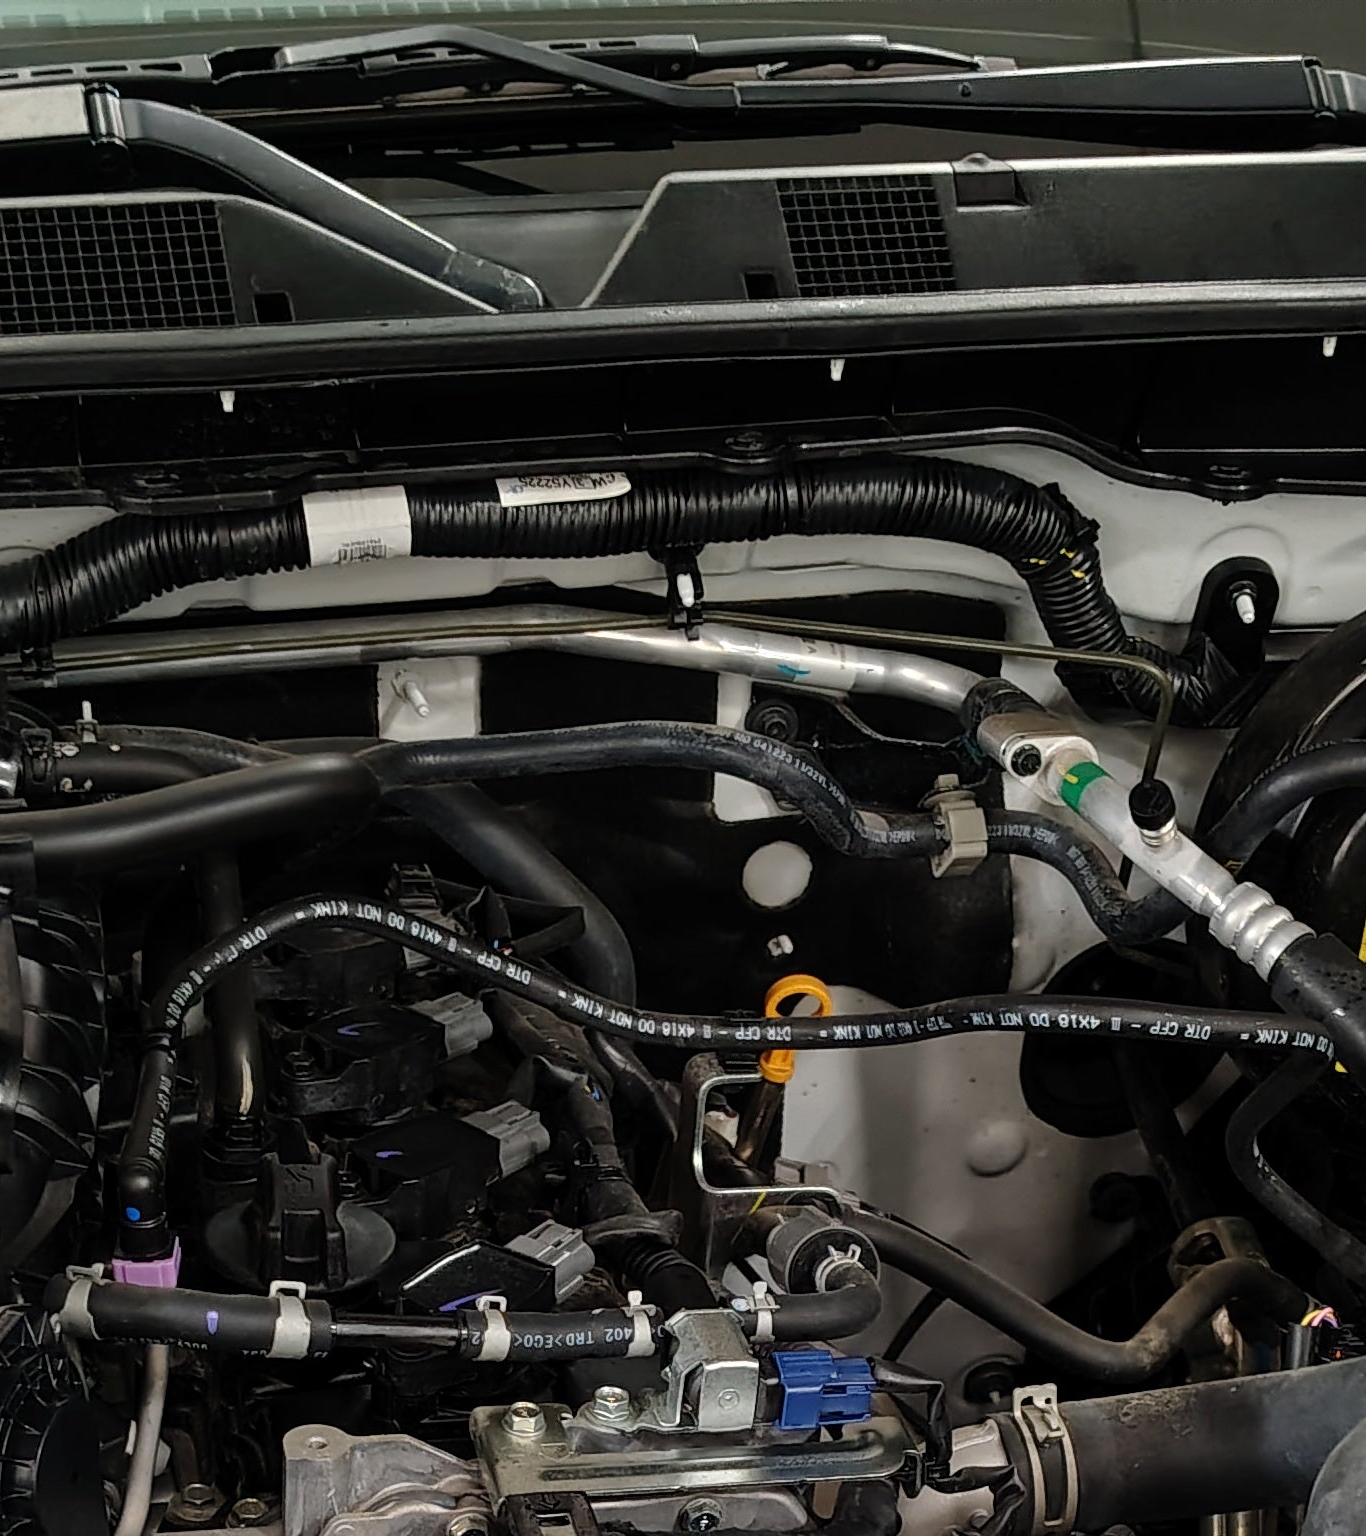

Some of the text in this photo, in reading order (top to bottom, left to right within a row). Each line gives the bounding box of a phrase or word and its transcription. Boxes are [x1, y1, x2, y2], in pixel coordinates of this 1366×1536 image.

[310, 901, 349, 919] KINK
[355, 902, 382, 922] NOT
[387, 911, 405, 931] DO
[477, 951, 502, 972] CFP
[505, 965, 532, 986] DTR
[571, 993, 604, 1016] KINK
[607, 1011, 633, 1029] NOT
[637, 1018, 656, 1034] DO
[999, 1011, 1024, 1026] NOT
[1028, 1012, 1051, 1028] DO
[1057, 1013, 1101, 1030] 4X18
[735, 1026, 761, 1041] CFP
[767, 1026, 792, 1041] DTR
[833, 1024, 861, 1041] KINK
[1149, 1020, 1179, 1036] CFP
[1184, 1023, 1212, 1041] DTR
[1255, 1029, 1288, 1044] KINK
[1292, 1030, 1315, 1048] NOT
[604, 1328, 633, 1342] 402
